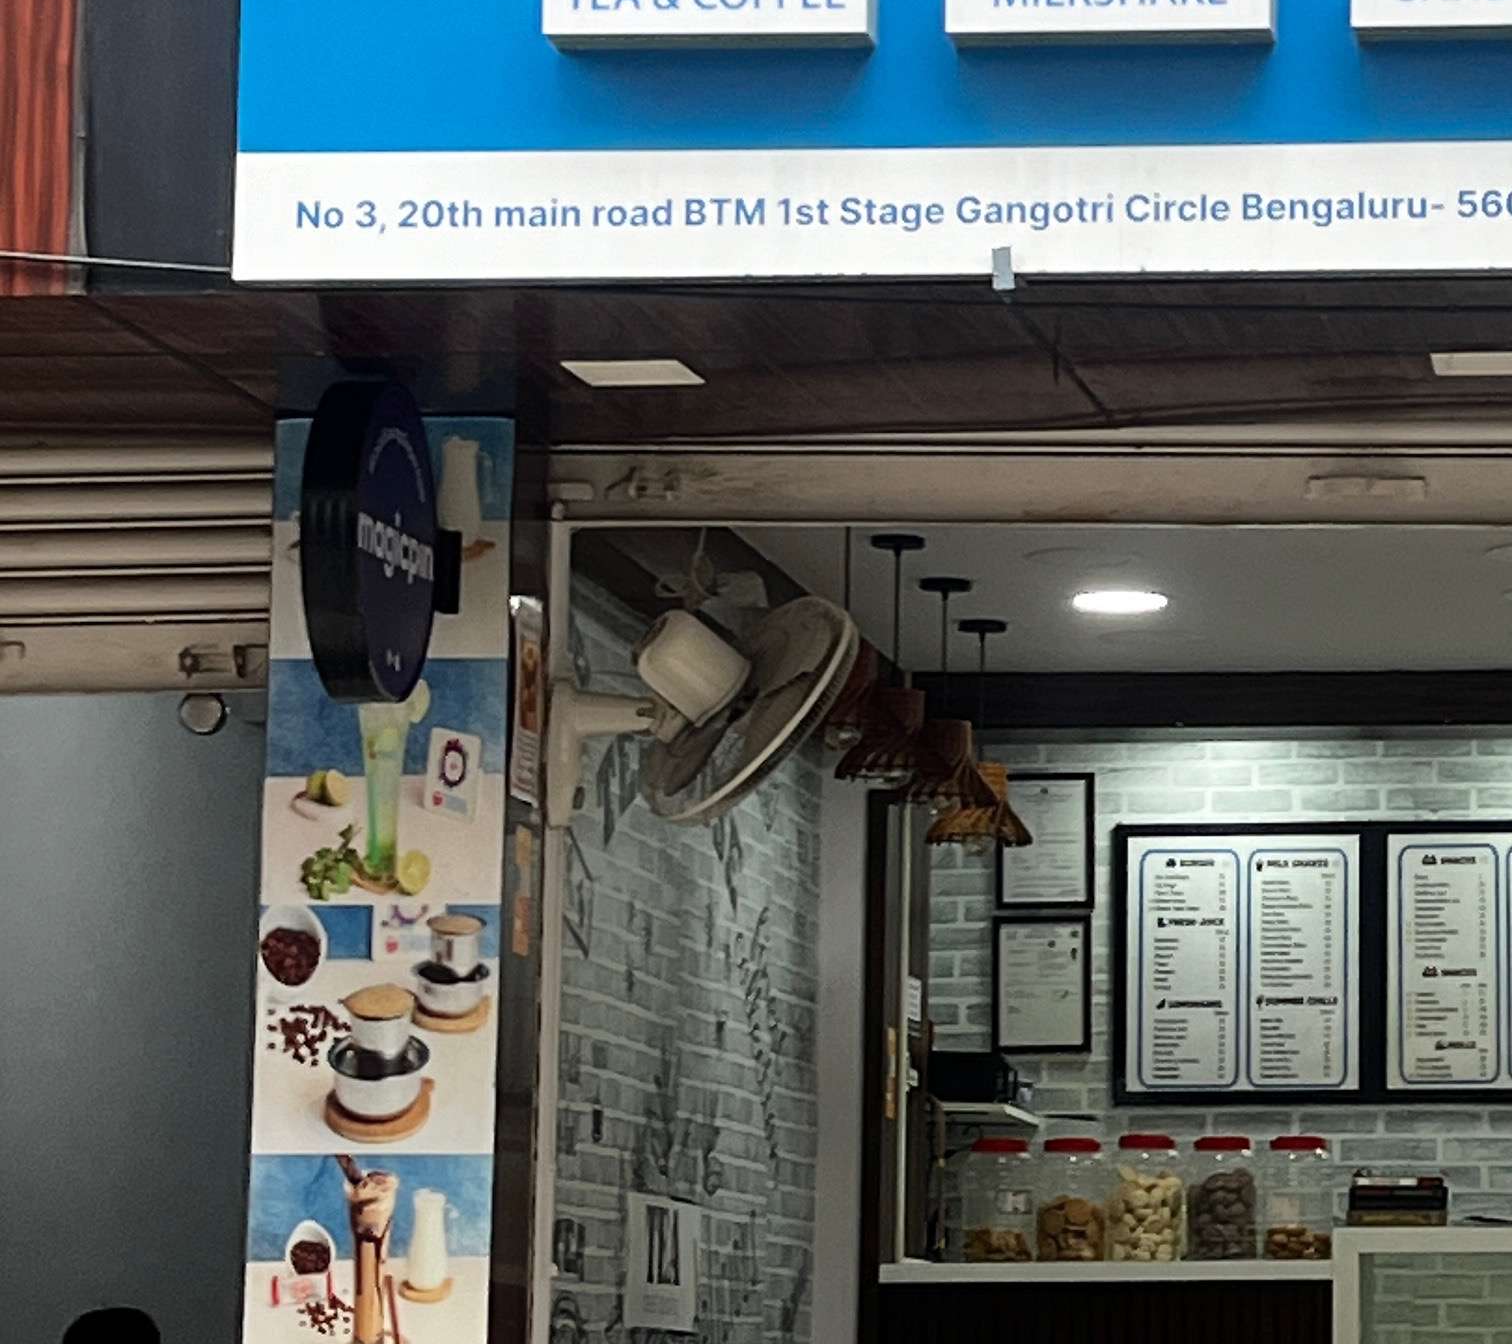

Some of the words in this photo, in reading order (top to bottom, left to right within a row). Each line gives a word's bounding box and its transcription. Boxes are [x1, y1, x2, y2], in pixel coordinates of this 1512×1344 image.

[296, 201, 345, 230] No
[353, 201, 388, 234] 3,
[397, 201, 484, 230] 20th
[492, 200, 582, 229] main
[592, 200, 674, 228] road
[683, 198, 766, 228] BTM
[776, 197, 831, 227] 1st
[839, 198, 946, 234] Stage
[955, 196, 1116, 233] Gangotri
[1123, 194, 1231, 226] Circle
[1241, 192, 1446, 230] Bengaluru-
